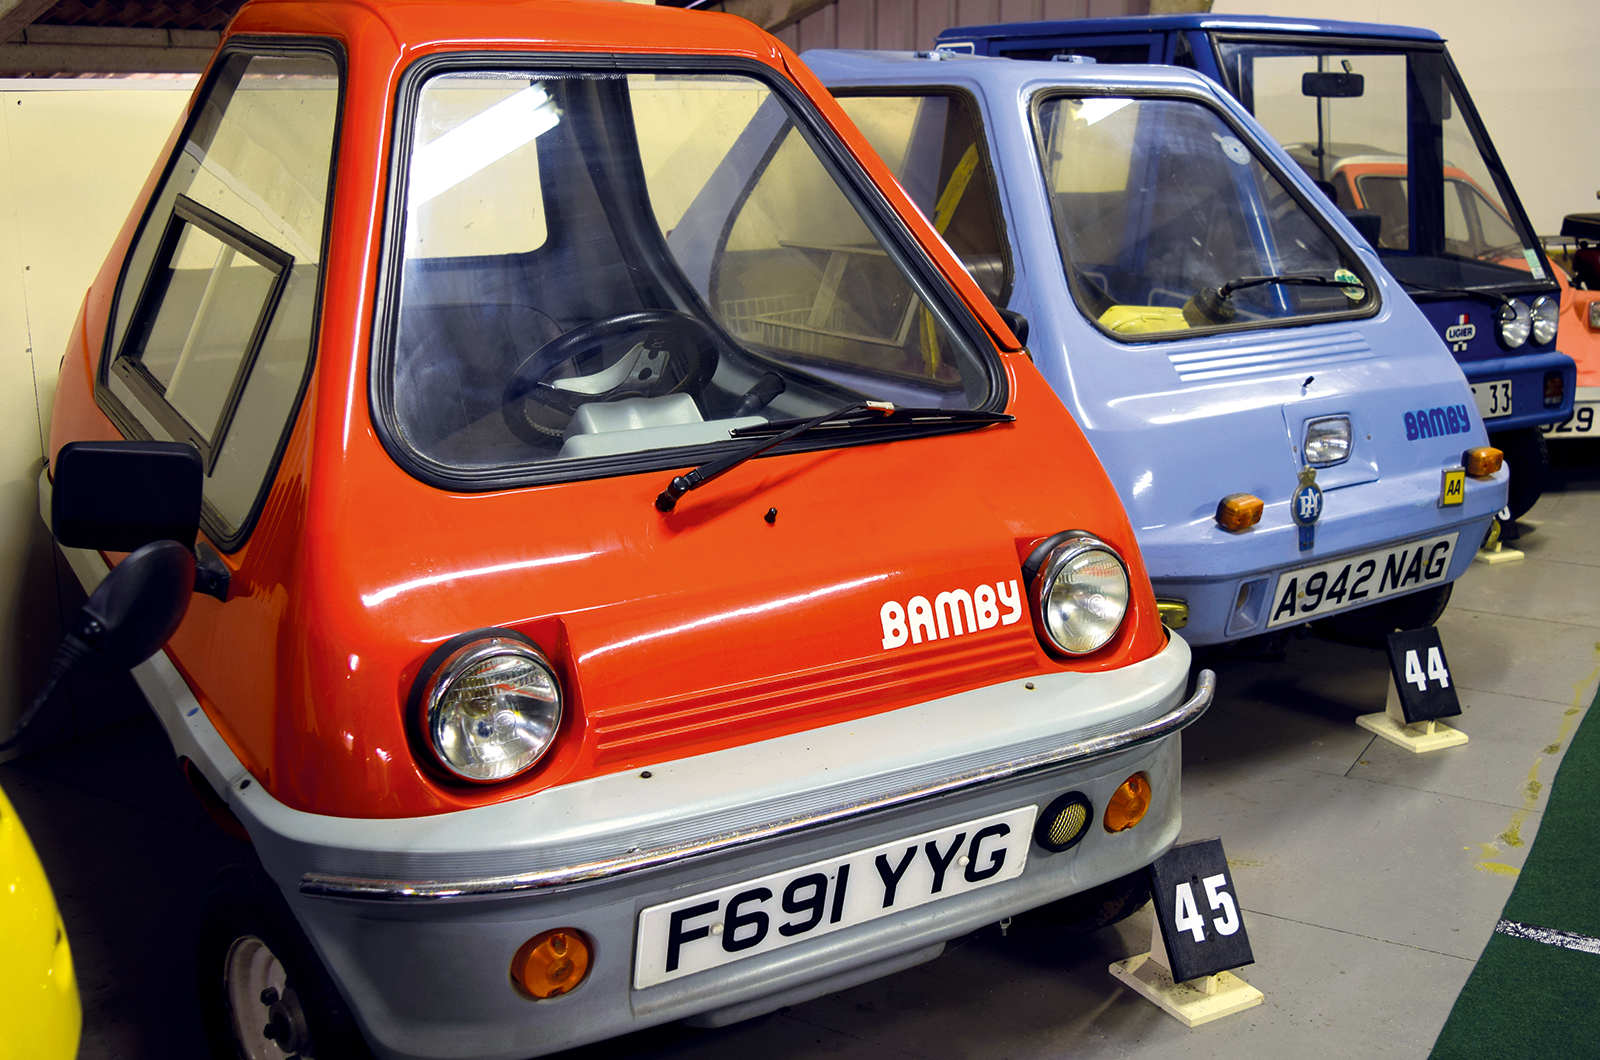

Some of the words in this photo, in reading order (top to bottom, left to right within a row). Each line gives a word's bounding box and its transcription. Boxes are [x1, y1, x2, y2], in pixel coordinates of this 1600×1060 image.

[1449, 327, 1473, 339] LIGIER
[1490, 383, 1510, 414] 33
[1404, 404, 1472, 441] BAMBY
[1446, 479, 1461, 496] AA
[1273, 559, 1377, 621] A942
[1378, 541, 1450, 594] NAG
[880, 579, 1023, 650] BAMBY
[1405, 646, 1449, 692] 44
[665, 863, 851, 973] F691
[875, 823, 1011, 909] YYG
[1175, 873, 1240, 943] 45
